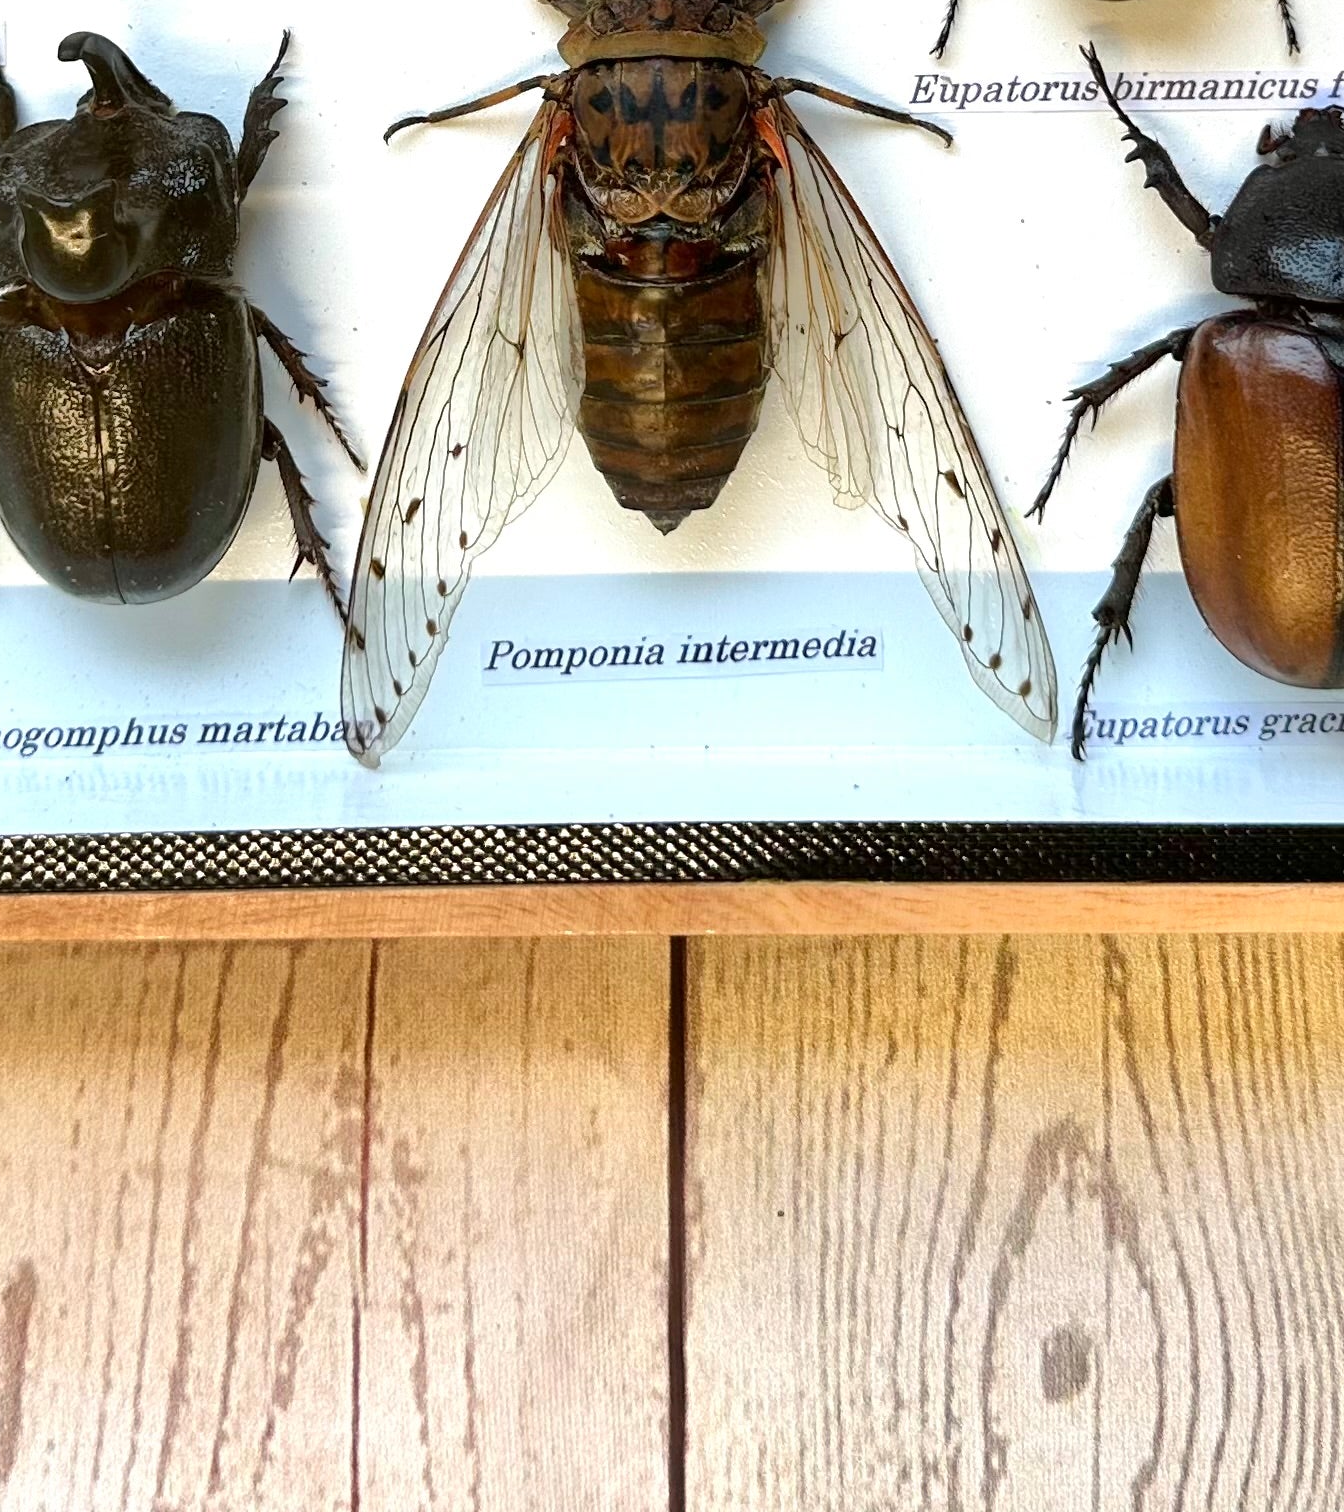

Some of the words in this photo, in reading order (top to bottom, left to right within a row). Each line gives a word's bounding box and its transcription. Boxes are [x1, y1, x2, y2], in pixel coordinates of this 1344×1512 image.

[908, 74, 1100, 109] Eupatorus
[1112, 71, 1319, 101] birmanicus
[482, 636, 665, 674] Pomponia
[676, 630, 877, 665] intermedia
[1066, 709, 1251, 745] Eupatorus
